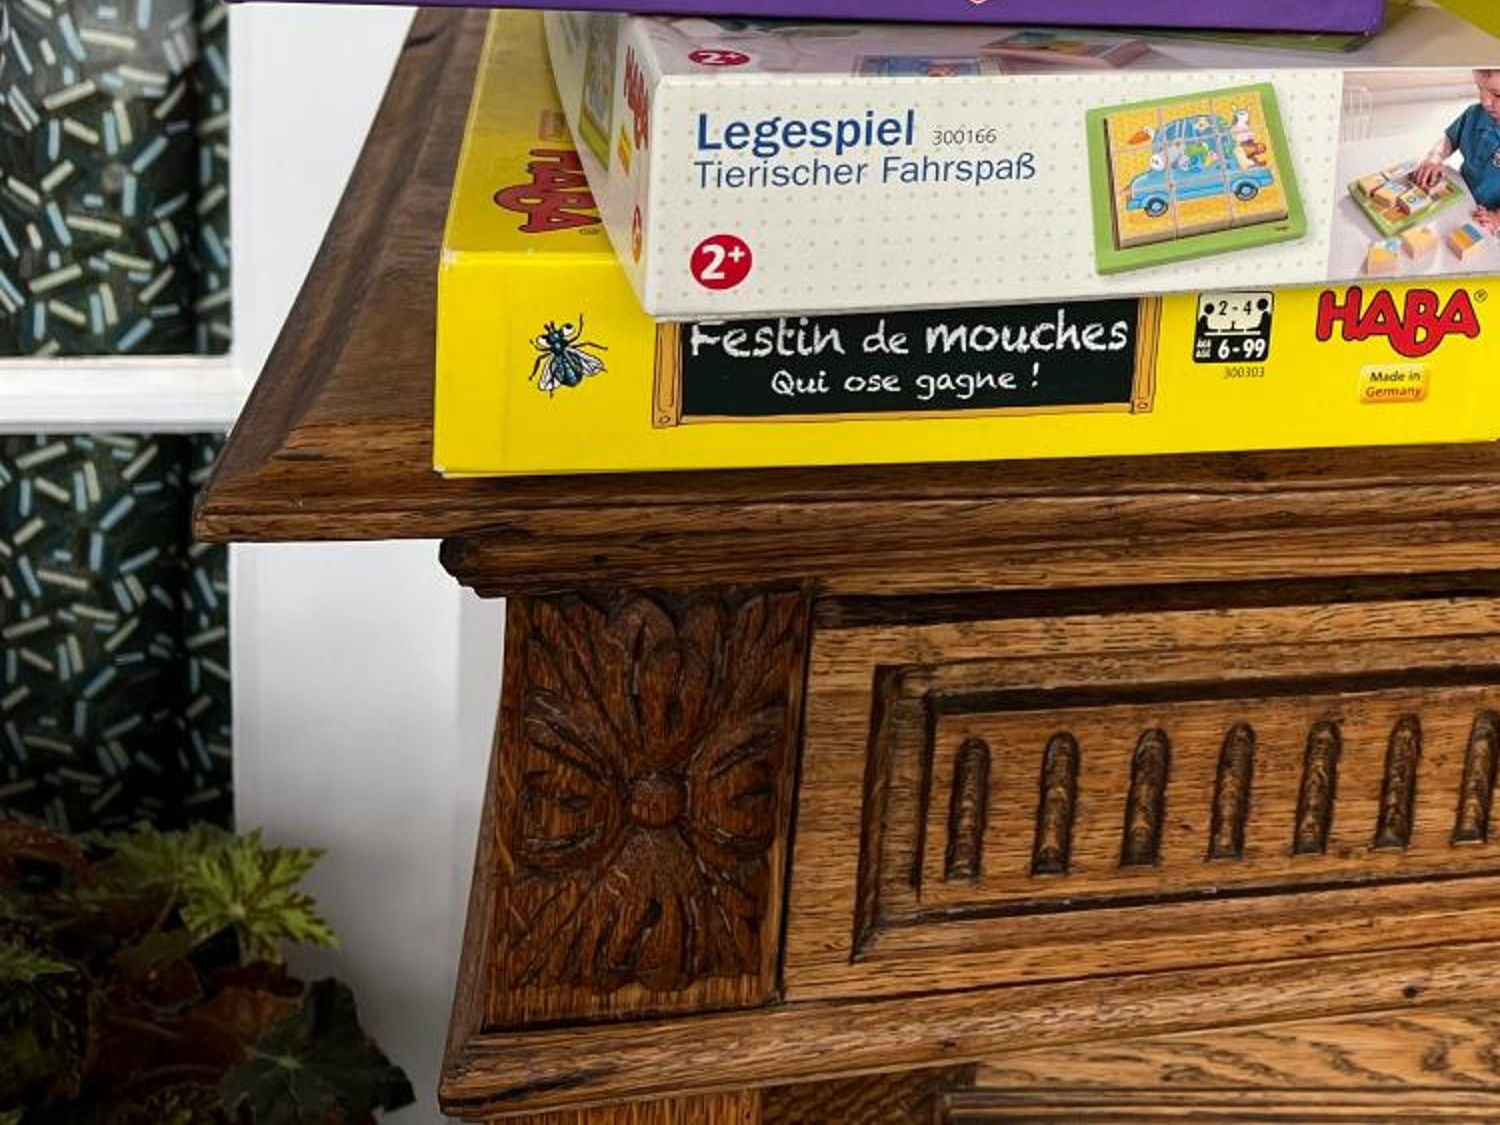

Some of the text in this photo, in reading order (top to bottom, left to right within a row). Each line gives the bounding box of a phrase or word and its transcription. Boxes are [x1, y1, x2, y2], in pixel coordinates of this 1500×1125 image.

[698, 109, 997, 158] Legespiel 300166
[693, 152, 1037, 189] Tierischer Fahrspaß
[700, 244, 747, 281] 2+
[689, 309, 1129, 359] Festin de mouches
[1315, 285, 1480, 358] HABA
[1217, 339, 1267, 360] 6-99
[771, 371, 829, 396] Qui
[843, 372, 900, 393] ose
[916, 369, 1018, 401] gagne
[1365, 385, 1422, 400] Germany
[1369, 371, 1421, 383] Made in
